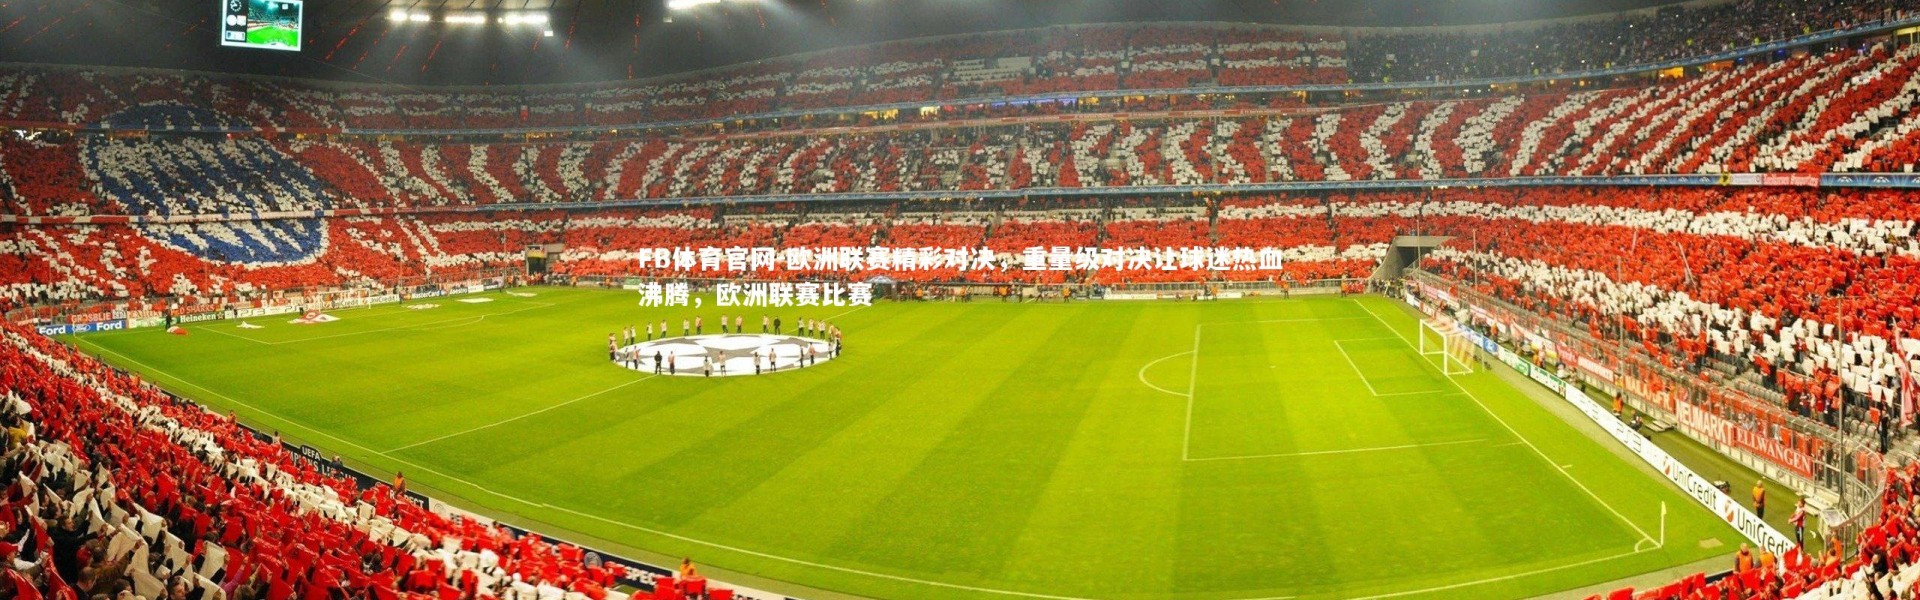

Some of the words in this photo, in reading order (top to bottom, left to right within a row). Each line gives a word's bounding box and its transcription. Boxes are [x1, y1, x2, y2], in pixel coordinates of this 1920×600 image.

[96, 320, 123, 331] Ford
[180, 313, 217, 323] Heineken
[39, 325, 66, 336] Ford
[302, 446, 320, 461] UEFA
[1736, 427, 1814, 477] ELLWANGEN
[1672, 463, 1718, 510] UniCredit
[1737, 509, 1793, 557] UniCredi
